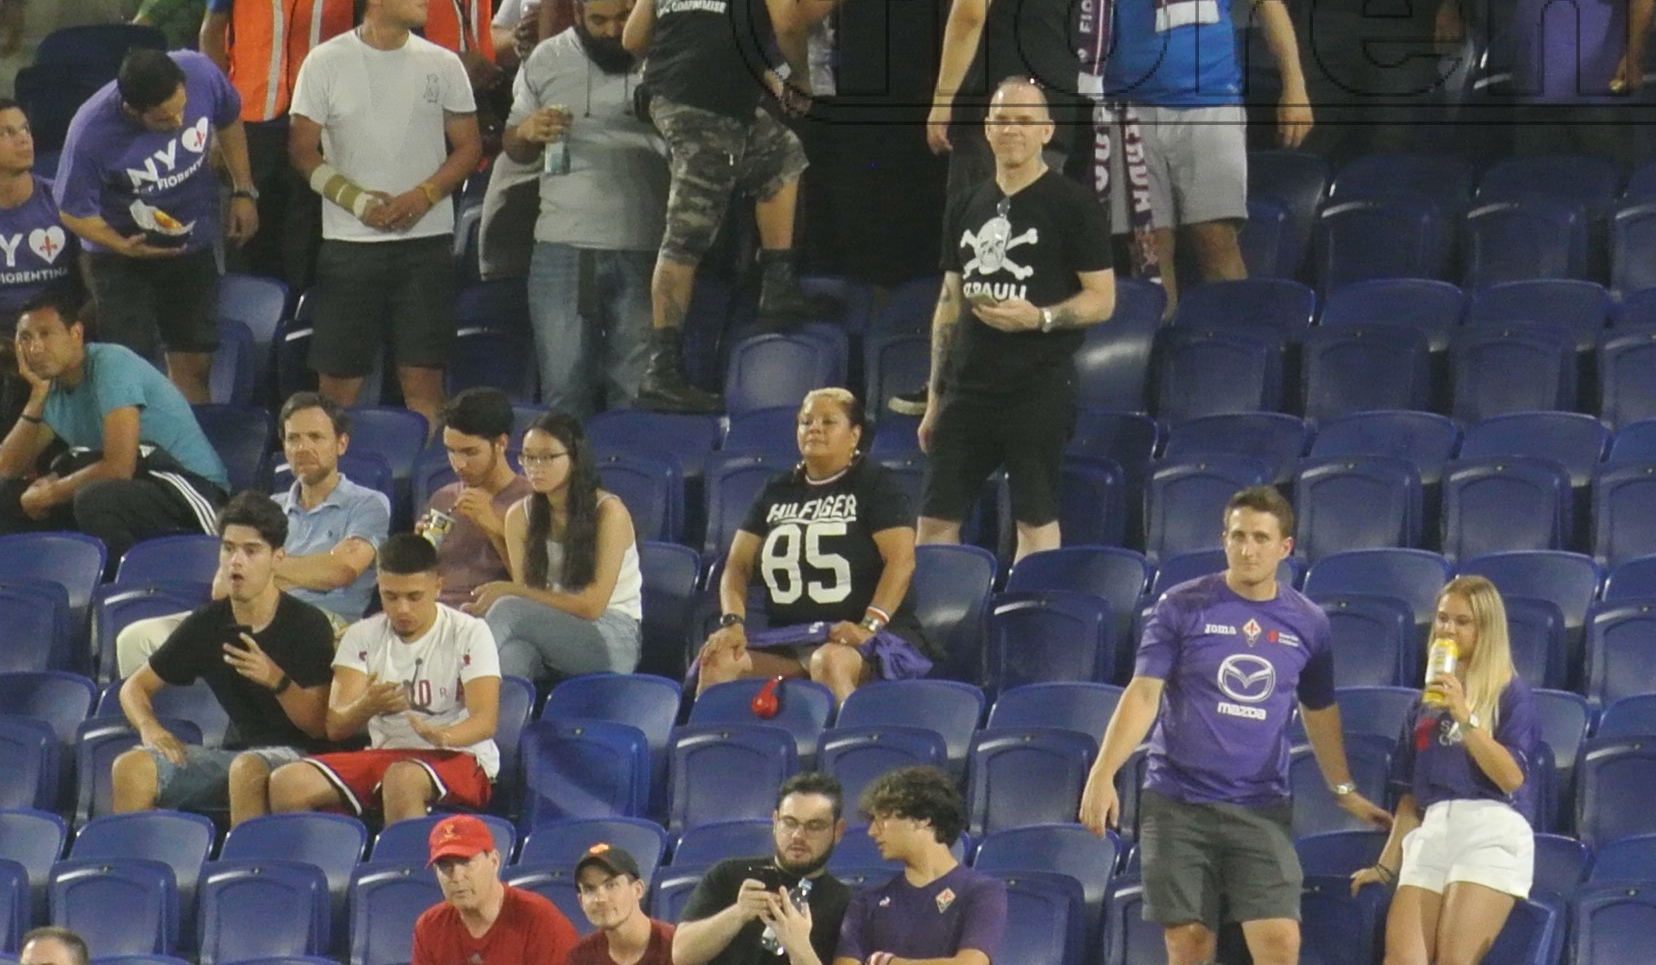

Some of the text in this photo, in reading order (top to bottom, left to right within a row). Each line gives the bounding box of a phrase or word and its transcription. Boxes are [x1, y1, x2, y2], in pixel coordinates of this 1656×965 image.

[127, 138, 178, 188] NY
[0, 232, 25, 268] Y
[765, 493, 859, 524] HILFIGER
[760, 522, 855, 605] 85
[1217, 701, 1267, 721] mazda
